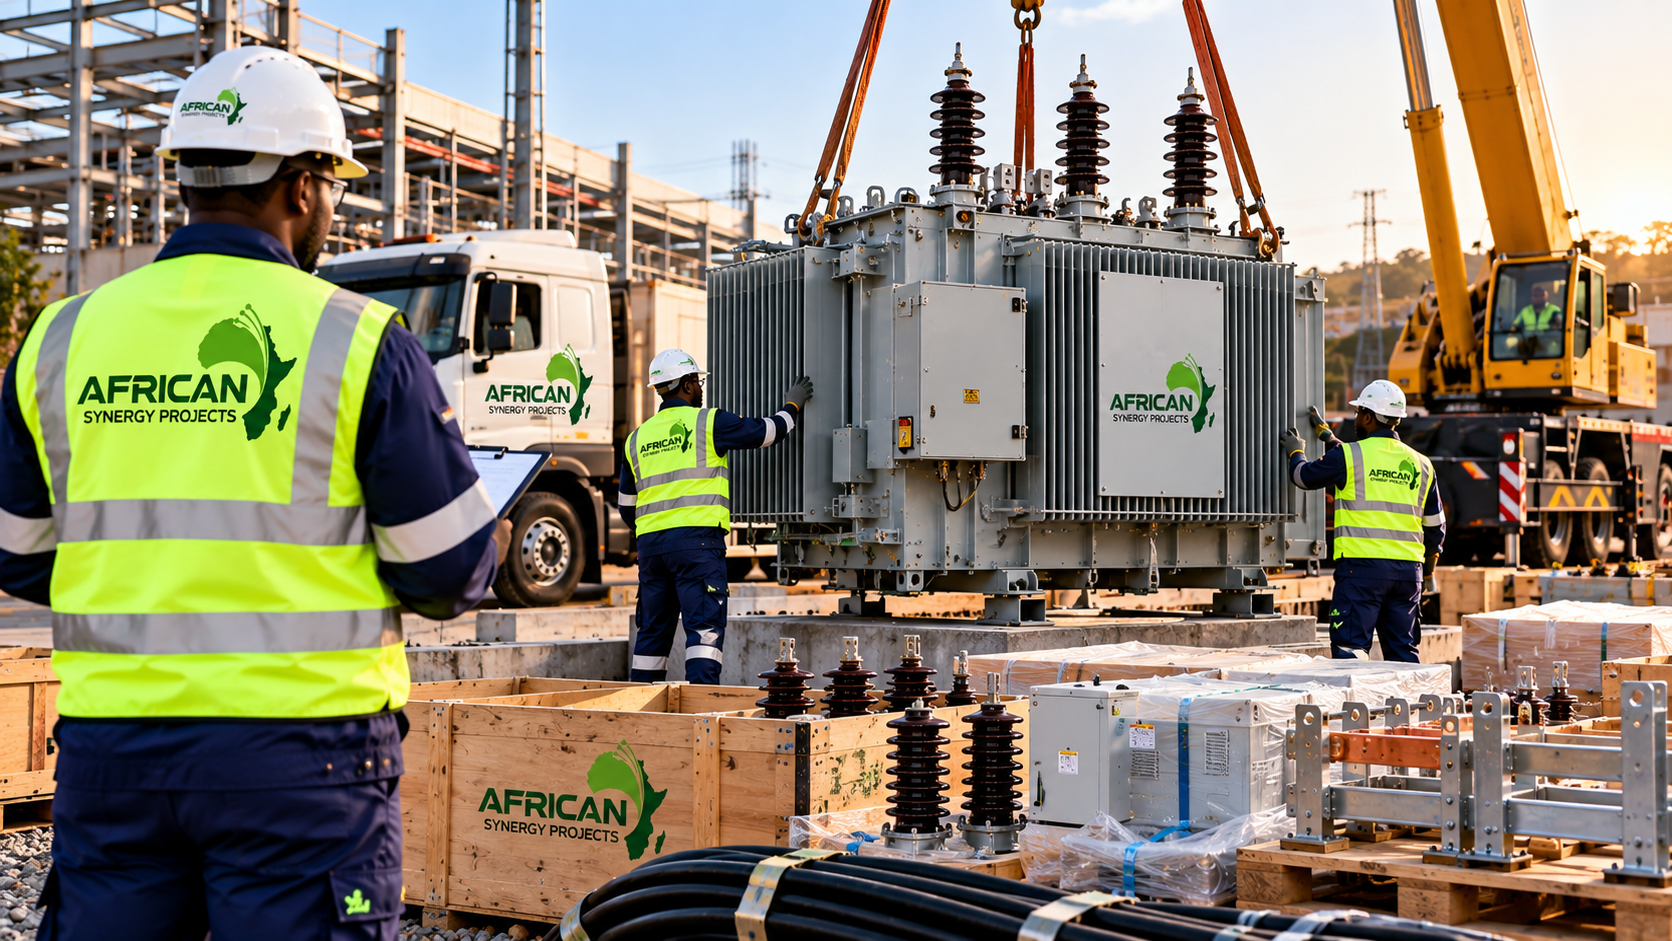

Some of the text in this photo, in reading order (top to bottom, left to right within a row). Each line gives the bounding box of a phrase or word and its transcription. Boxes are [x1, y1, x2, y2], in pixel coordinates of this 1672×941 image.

[180, 101, 231, 114] AFRICAN
[77, 374, 248, 405] AFRICAN
[484, 384, 571, 404] AFRICAN
[488, 405, 567, 415] SYNERGY PROJECTS
[1110, 393, 1193, 412] AFRICAN
[83, 409, 237, 424] SYNERGY PROJECTS
[1112, 413, 1189, 424] SYNERGY PROJECTS
[1368, 468, 1411, 481] AFRICAN
[477, 787, 627, 827] AFRICAN
[483, 818, 619, 843] SYNERGY PROJECTS
